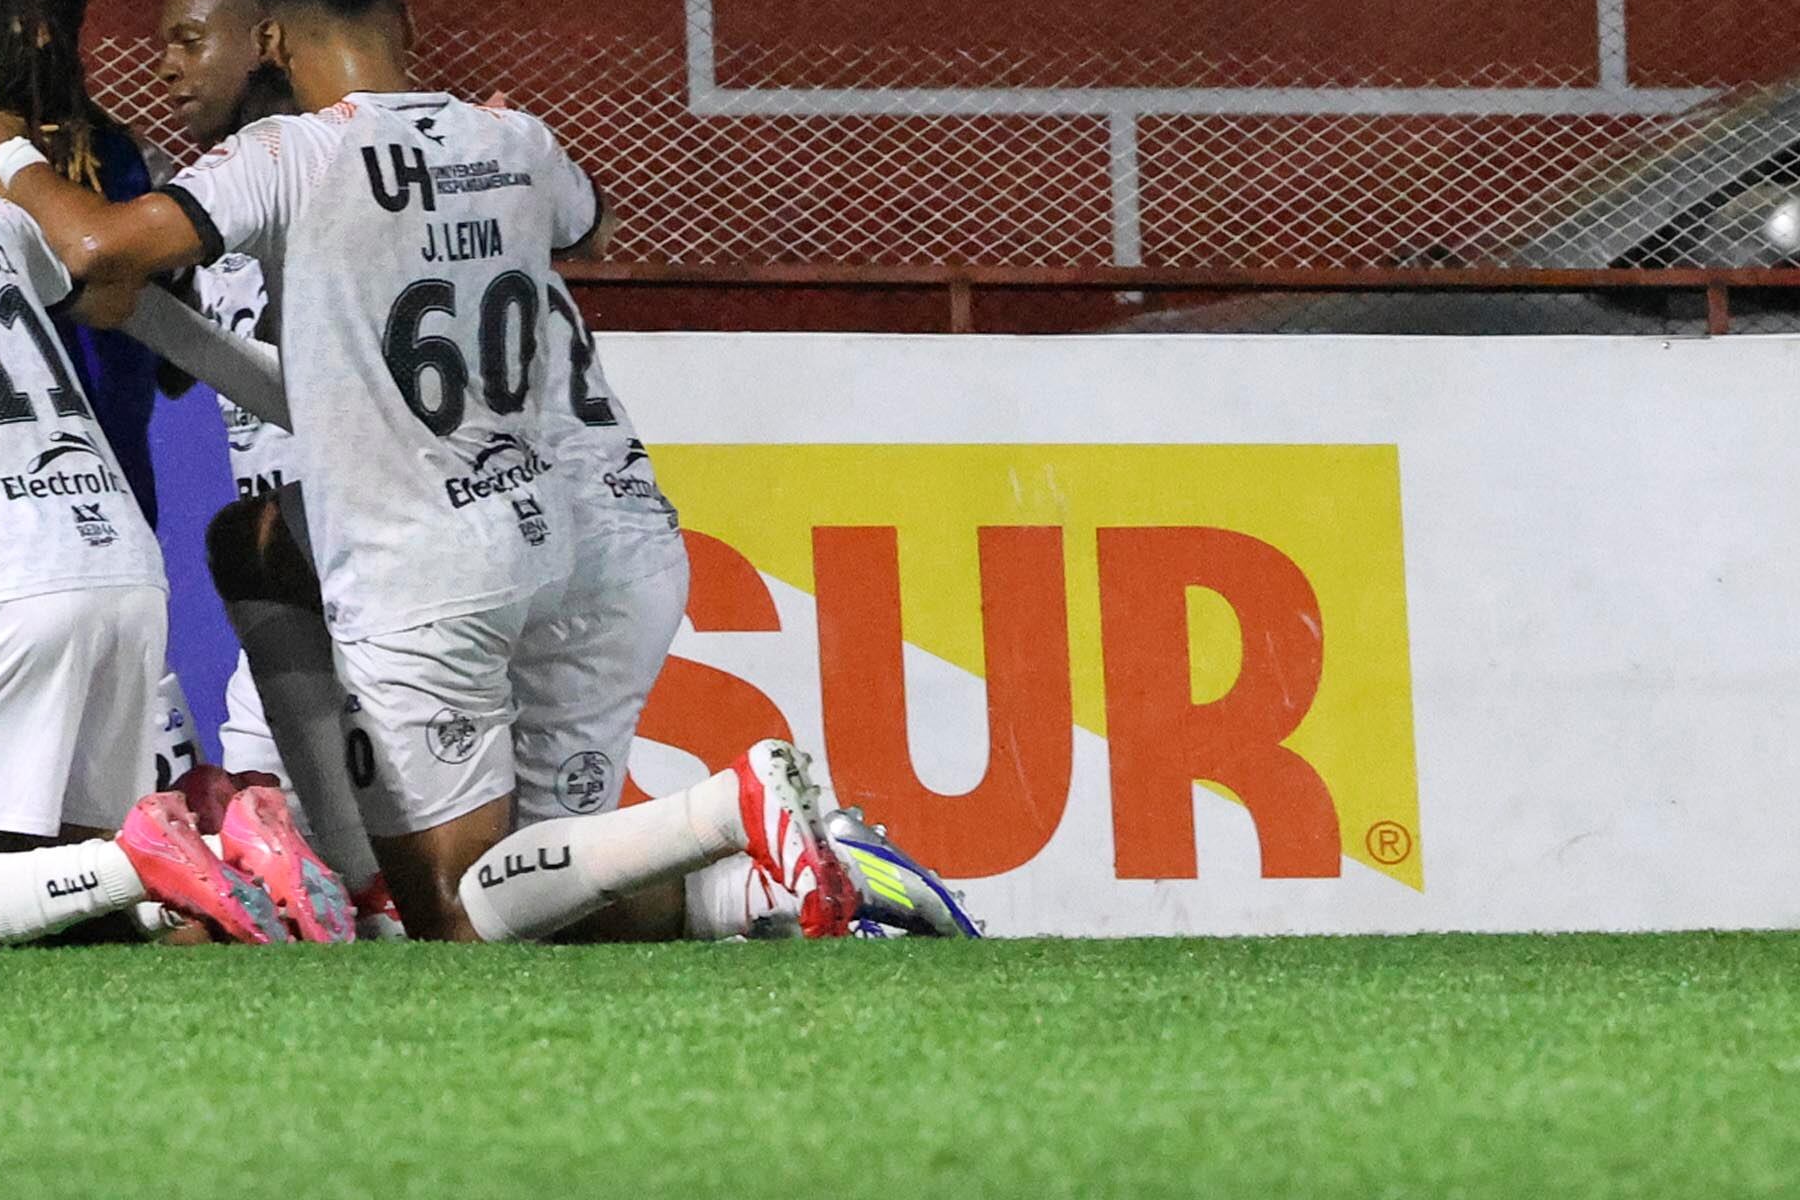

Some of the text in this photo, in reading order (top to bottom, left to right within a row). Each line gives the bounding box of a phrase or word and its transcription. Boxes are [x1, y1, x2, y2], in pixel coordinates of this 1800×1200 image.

[360, 143, 436, 212] UH
[444, 218, 502, 261] LEIVA
[383, 269, 538, 437] 60
[47, 870, 99, 899] PFC
[478, 845, 572, 889] PFC
